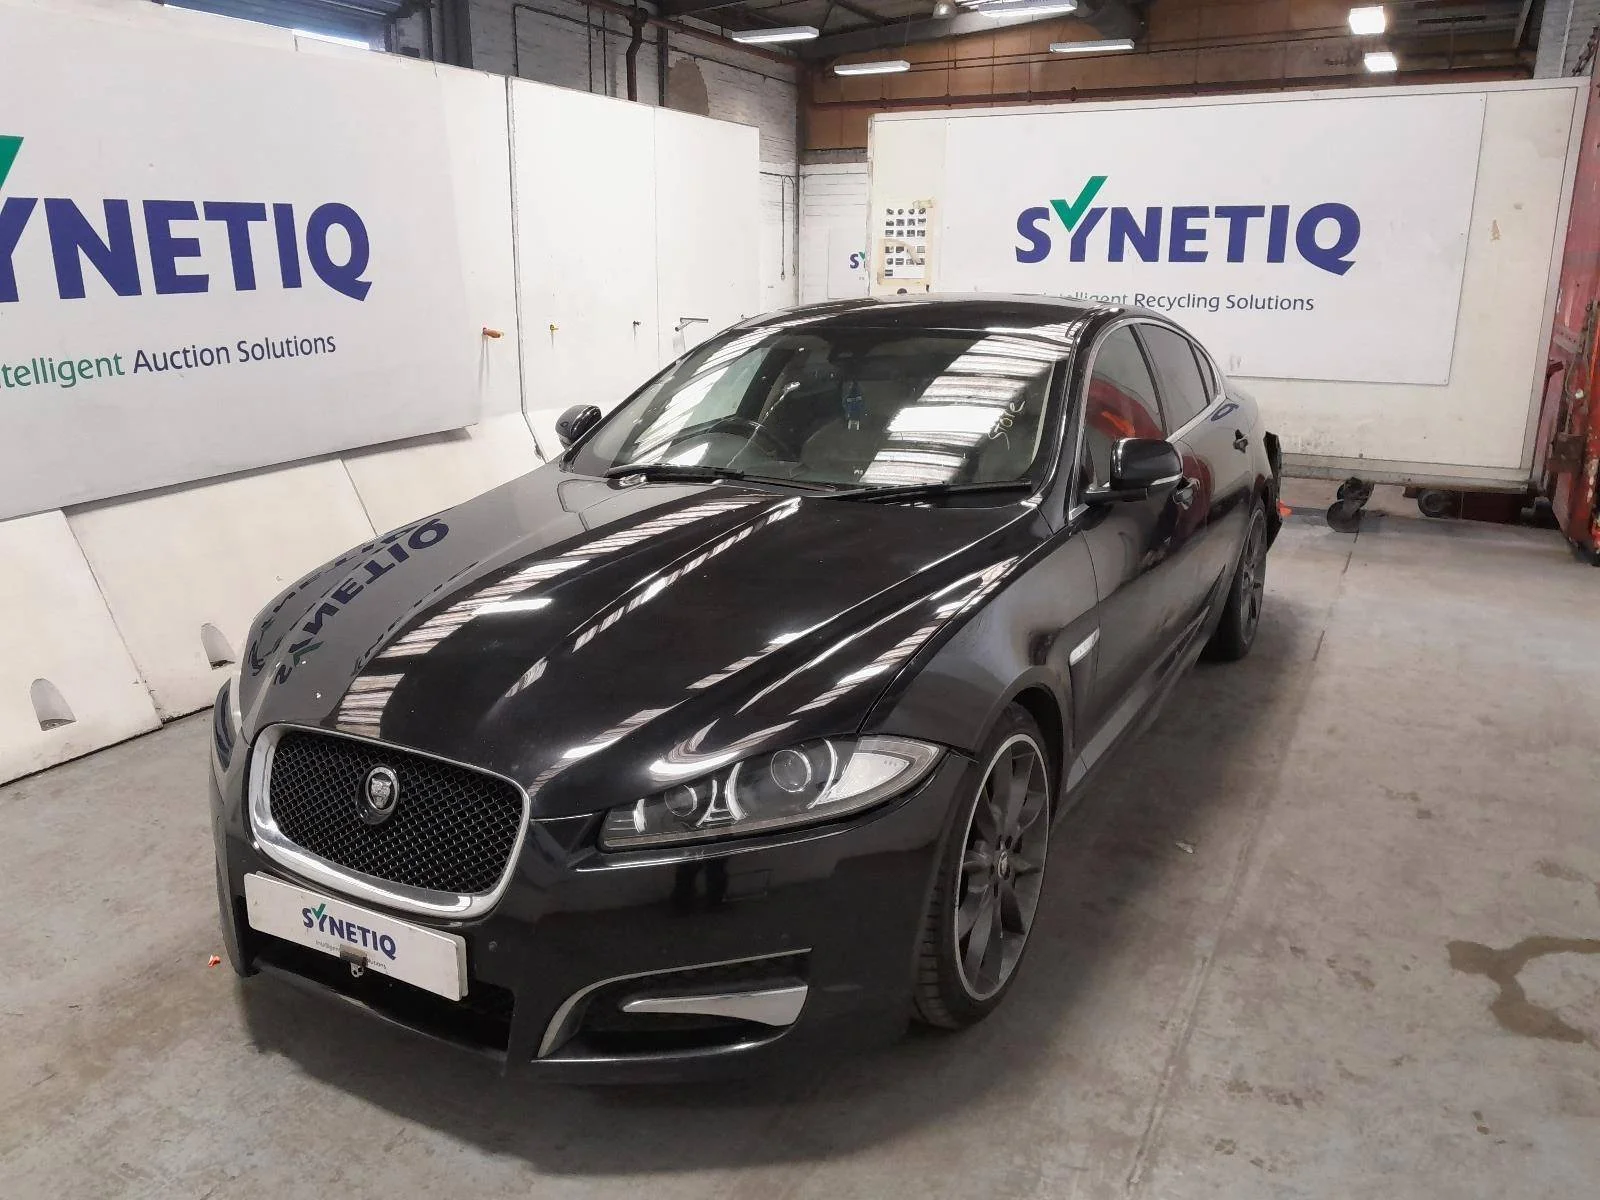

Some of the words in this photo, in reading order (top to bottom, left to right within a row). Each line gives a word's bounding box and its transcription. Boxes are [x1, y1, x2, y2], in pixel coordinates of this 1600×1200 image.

[0, 197, 372, 302] YNETIQ
[1015, 202, 1361, 276] SYNETIQ
[1134, 292, 1220, 313] Recycling
[1226, 295, 1314, 311] Solutions
[0, 352, 125, 388] telligent
[133, 344, 231, 374] Auction
[236, 335, 337, 363] Solutions
[301, 904, 396, 960] SYNETIQ
